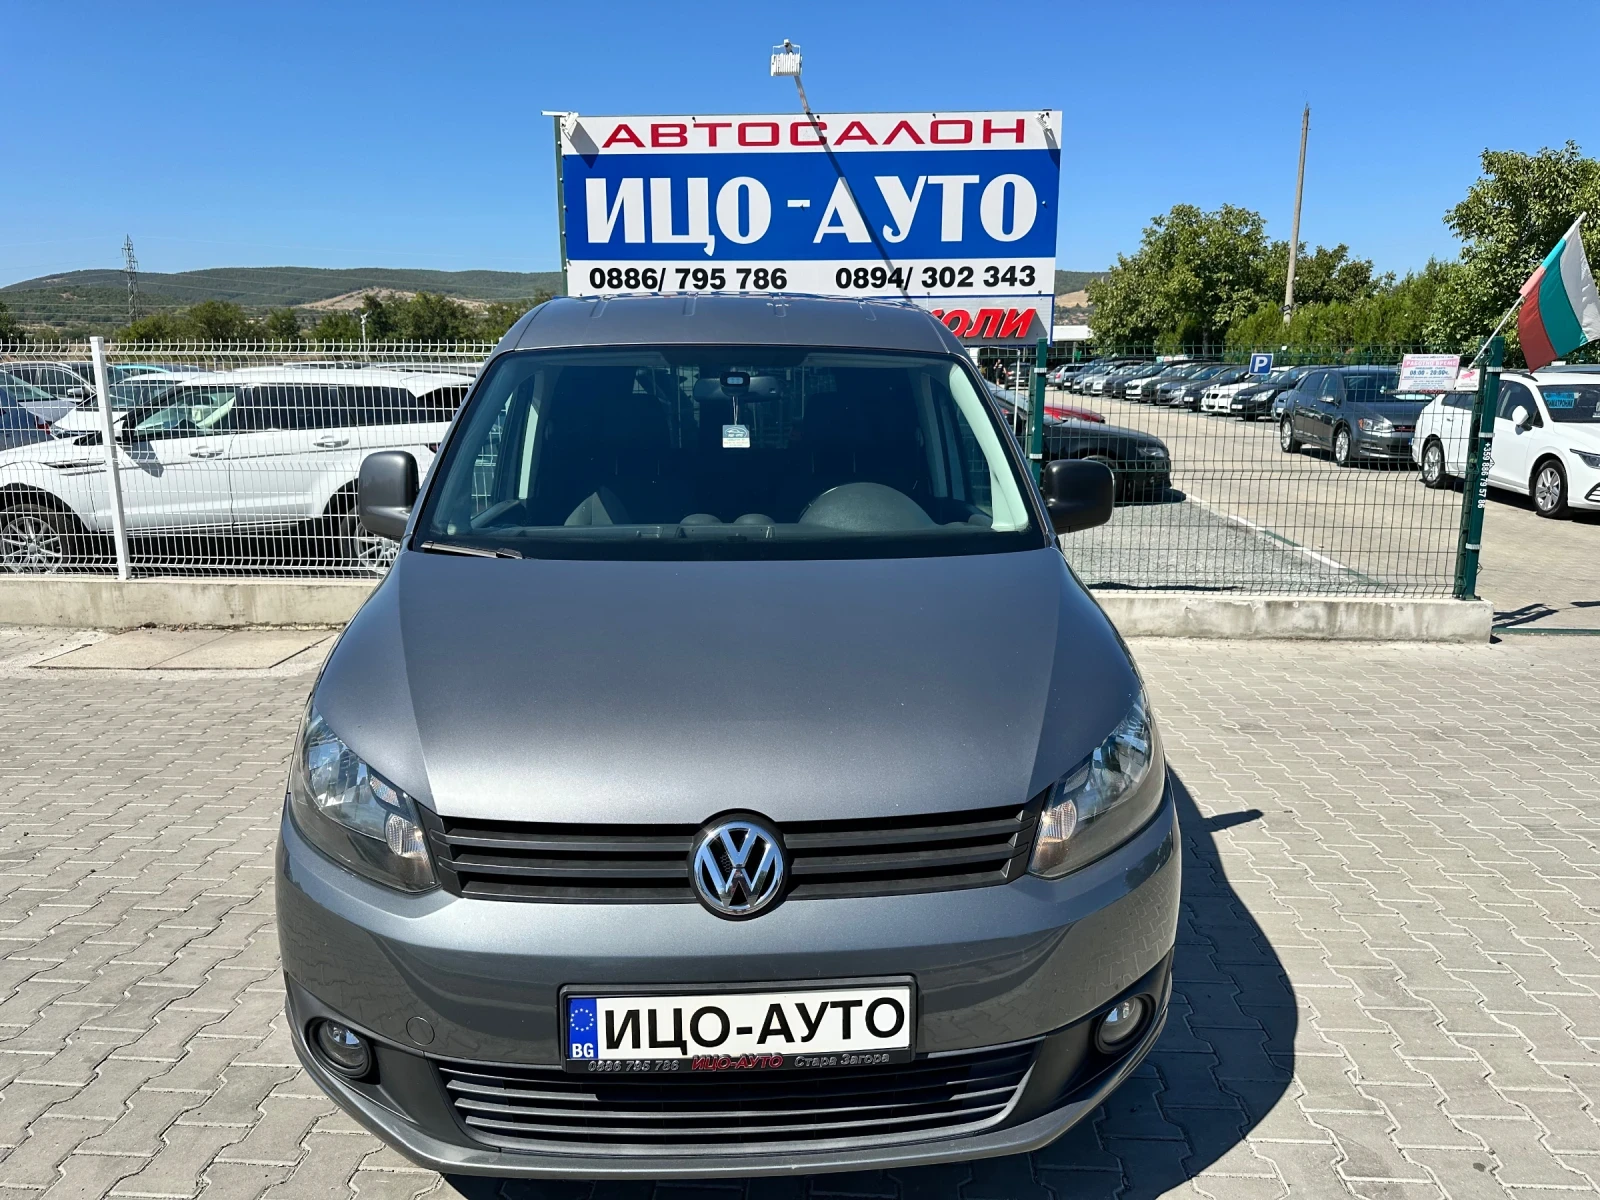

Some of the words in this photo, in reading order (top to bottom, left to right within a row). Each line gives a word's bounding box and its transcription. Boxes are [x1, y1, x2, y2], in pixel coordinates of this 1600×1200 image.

[602, 118, 1025, 148] АВТОСАЛОН
[588, 267, 667, 291] 0886/
[675, 268, 726, 290] 795
[736, 267, 788, 289] 786
[835, 266, 913, 290] 0894/
[922, 266, 974, 288] 302
[983, 265, 1036, 287] 343
[1254, 356, 1268, 372] P
[604, 997, 905, 1055] ИЦО-АУТО
[572, 1042, 594, 1058] BG
[588, 1060, 622, 1072] 0886
[625, 1060, 652, 1072] 795
[654, 1060, 680, 1071] 786
[692, 1053, 783, 1071] ИЦО-АУТО
[794, 1055, 837, 1068] Стара
[840, 1053, 890, 1067] Загора
